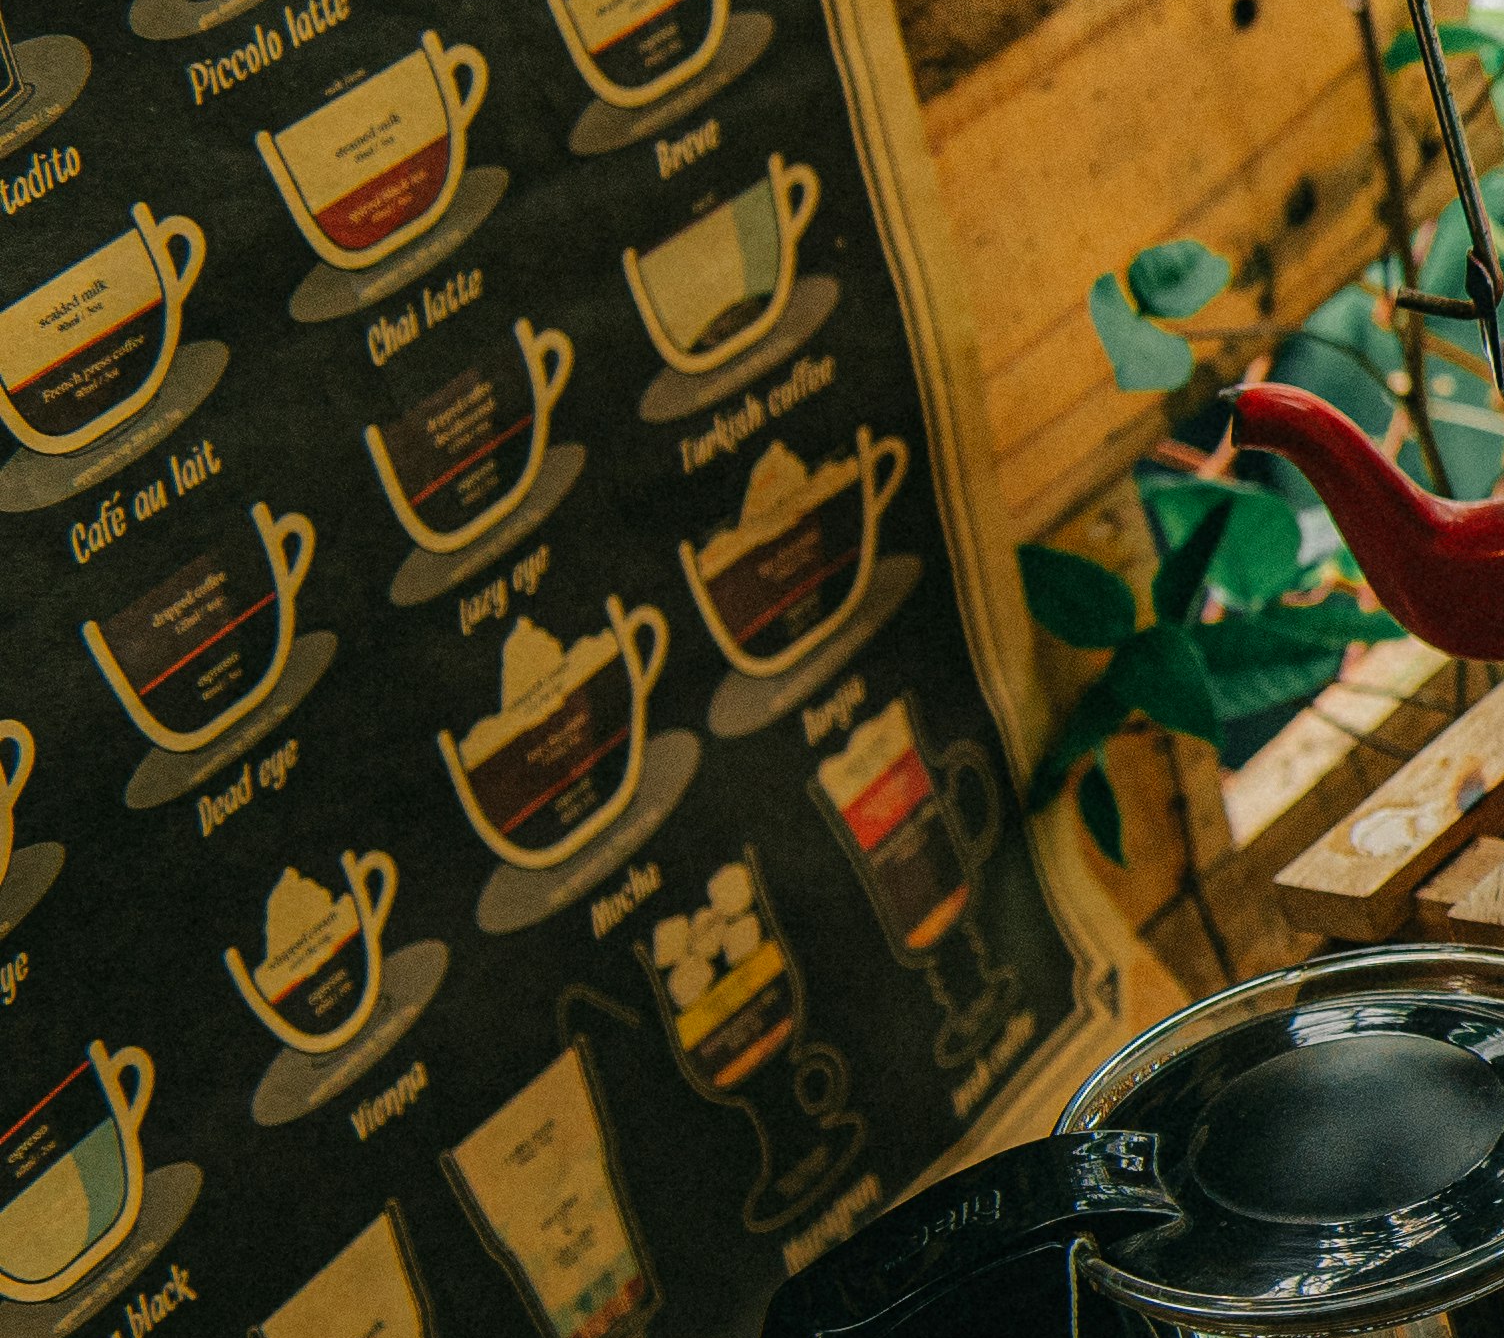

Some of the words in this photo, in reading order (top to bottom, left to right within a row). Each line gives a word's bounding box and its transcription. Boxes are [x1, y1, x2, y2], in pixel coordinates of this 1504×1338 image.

[189, 24, 284, 106] Piccolo
[81, 279, 108, 302] milk
[368, 302, 420, 367] Chai
[423, 268, 483, 329] latte
[71, 491, 128, 564] Café
[134, 480, 169, 522] au
[169, 440, 222, 495] lait
[198, 762, 253, 838] Dead
[259, 739, 299, 791] eye
